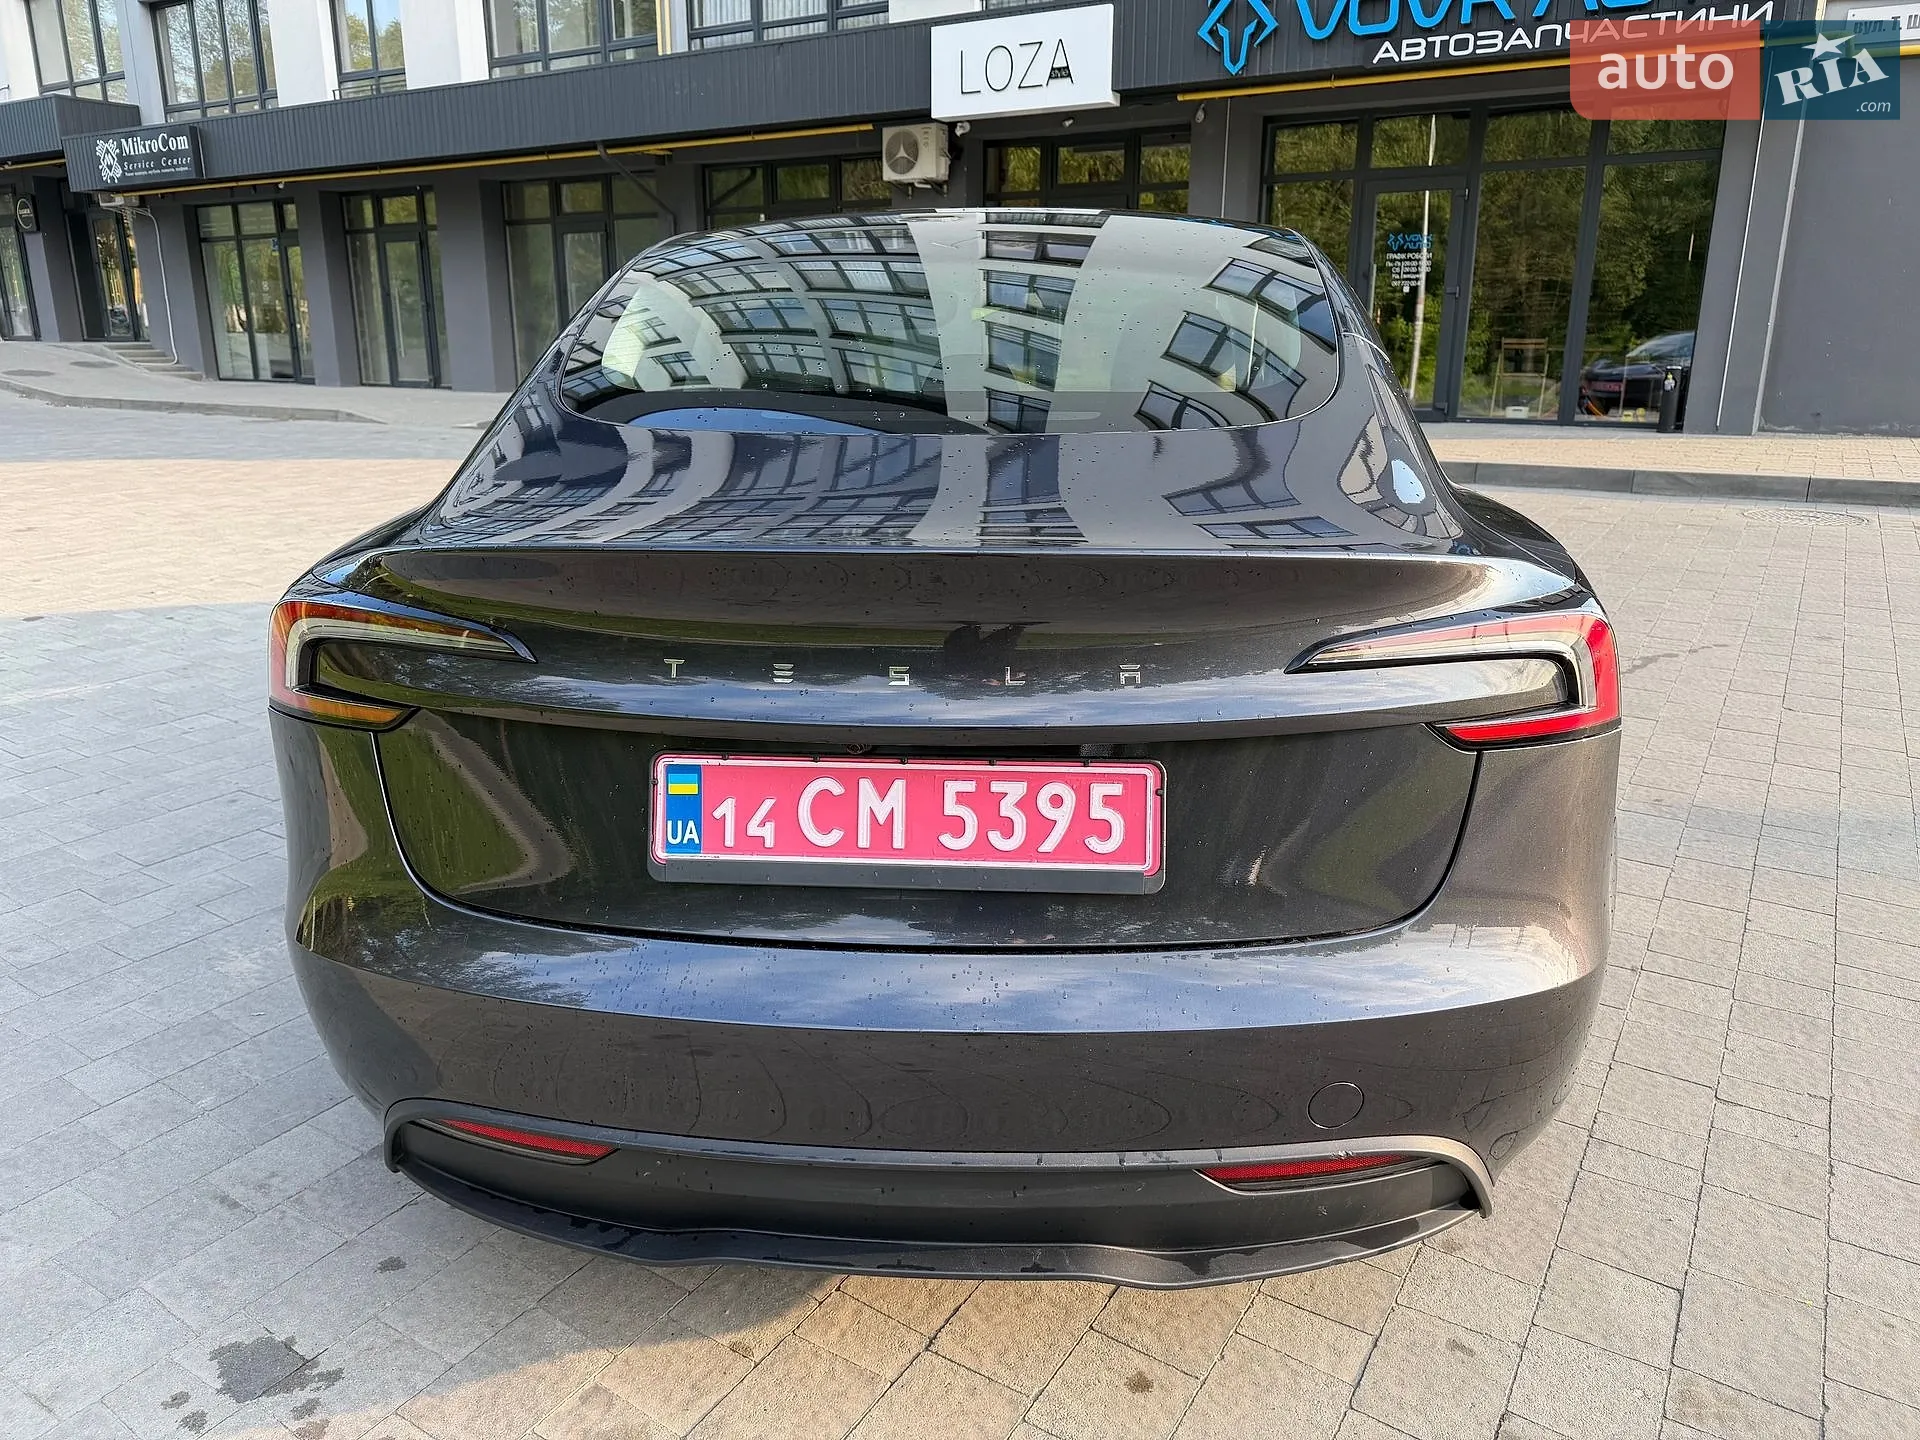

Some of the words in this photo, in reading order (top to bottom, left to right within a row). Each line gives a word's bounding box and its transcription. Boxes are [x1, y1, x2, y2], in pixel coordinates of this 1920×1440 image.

[1372, 0, 1774, 64] АВТОЗАПЧАСТИНИ
[960, 38, 1074, 95] LOZA
[120, 133, 189, 157] MikroCom
[123, 160, 155, 171] Service
[161, 156, 191, 167] Center
[663, 658, 1142, 687] TESLA
[711, 796, 777, 849] 14
[797, 776, 906, 850] CM
[937, 779, 1126, 855] 5395
[665, 818, 700, 845] UA
